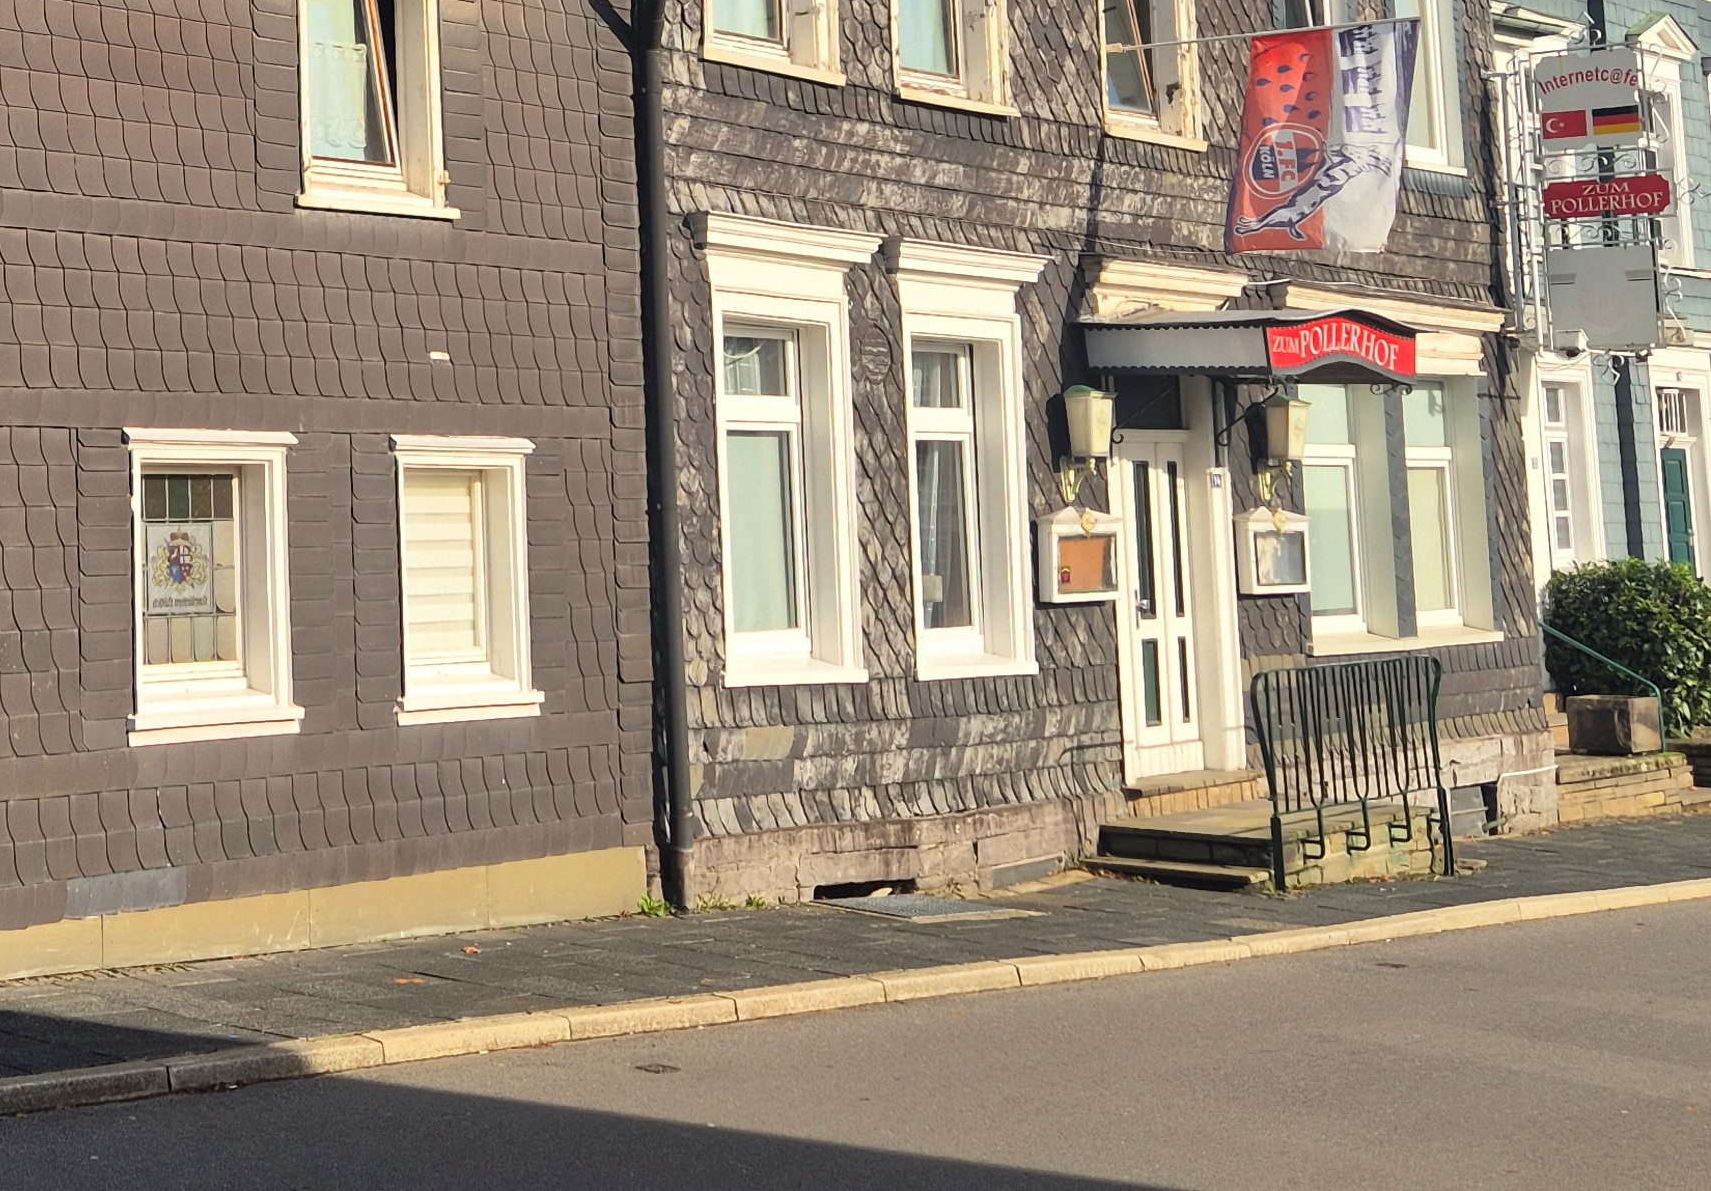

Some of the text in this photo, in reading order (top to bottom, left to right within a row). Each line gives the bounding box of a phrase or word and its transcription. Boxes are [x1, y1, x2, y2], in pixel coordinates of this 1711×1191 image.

[1538, 67, 1639, 96] Internetc@fe
[1258, 145, 1276, 178] KÖLN
[1581, 181, 1631, 194] ZUM
[1550, 191, 1664, 215] POLLERHOF
[1272, 321, 1400, 371] ZUM POLLERHOF
